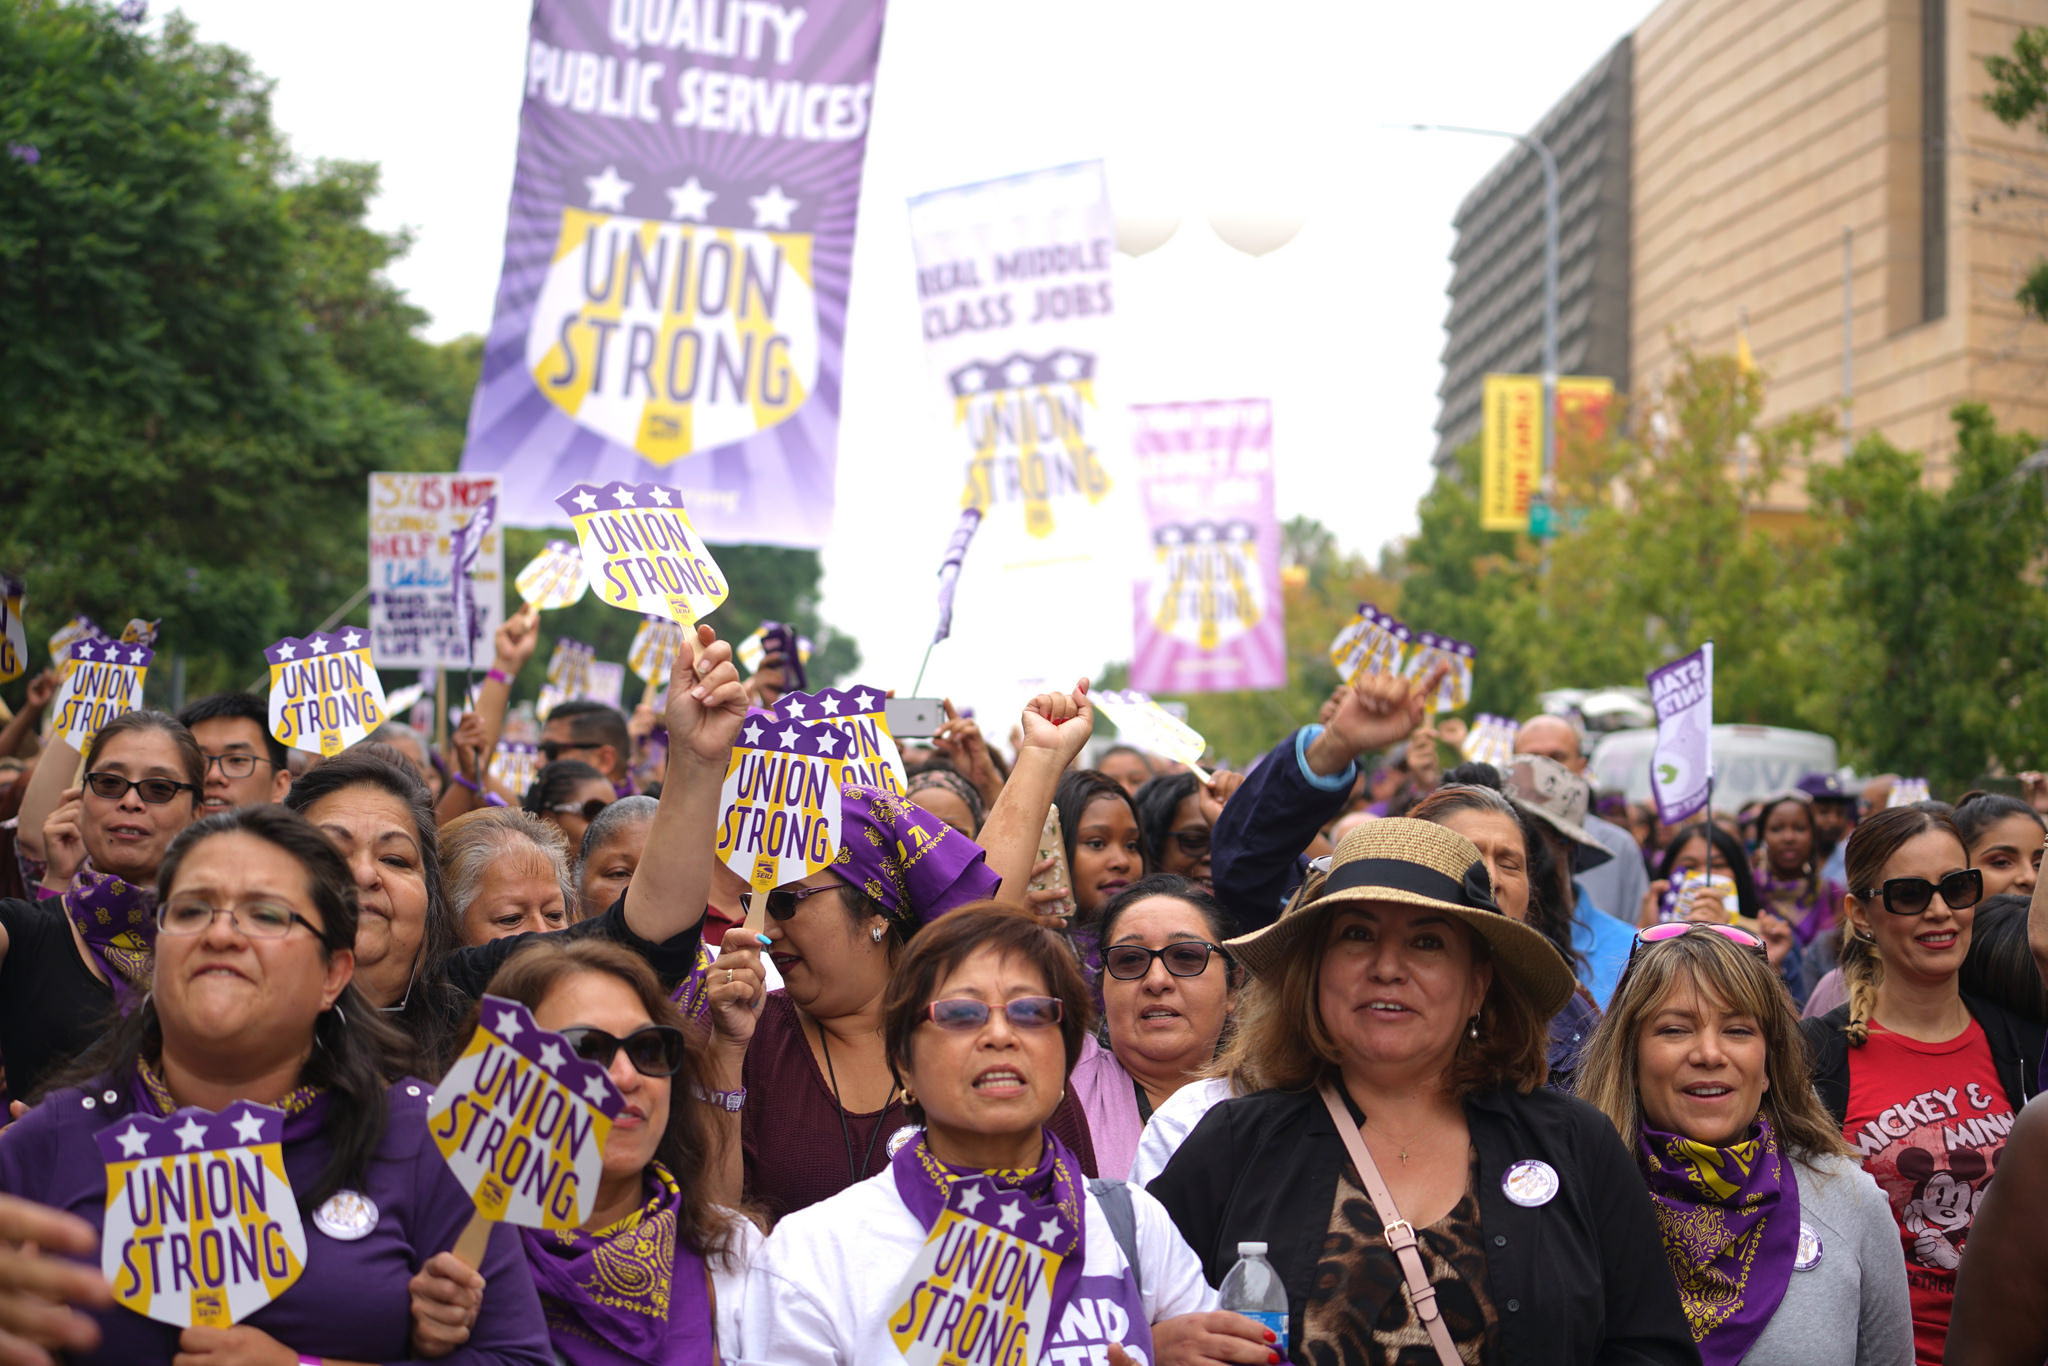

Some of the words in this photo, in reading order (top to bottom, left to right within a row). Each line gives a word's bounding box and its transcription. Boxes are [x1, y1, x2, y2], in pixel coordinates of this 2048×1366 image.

[609, 0, 807, 64] QUALITY
[529, 42, 667, 122] PUBLIC
[674, 67, 872, 142] SERVICES
[582, 224, 784, 322] UNION
[994, 238, 1110, 282] MIDDLE
[923, 294, 1015, 342] CLASS
[1029, 281, 1113, 323] JOBS
[549, 313, 793, 407] STRONG
[967, 393, 1085, 453] UNION
[965, 446, 1107, 508] STRONG
[587, 512, 693, 556] UNION
[602, 555, 722, 602] STRONG
[72, 663, 137, 700] UNION
[281, 655, 365, 699] UNION
[279, 690, 377, 739] STRONG
[737, 754, 831, 810] UNION
[718, 804, 830, 864] STRONG
[474, 1043, 594, 1162] UNION
[1851, 1086, 1958, 1163] MICKEY
[1964, 1082, 1993, 1110] &
[1943, 1110, 2015, 1154] MINN
[437, 1094, 580, 1222] STRONG
[1685, 1162, 1722, 1202] LOCAL
[125, 1154, 267, 1228] UNION
[121, 1221, 289, 1299] STRONG
[934, 1220, 1046, 1312] UNION
[895, 1280, 1031, 1366] STRONG
